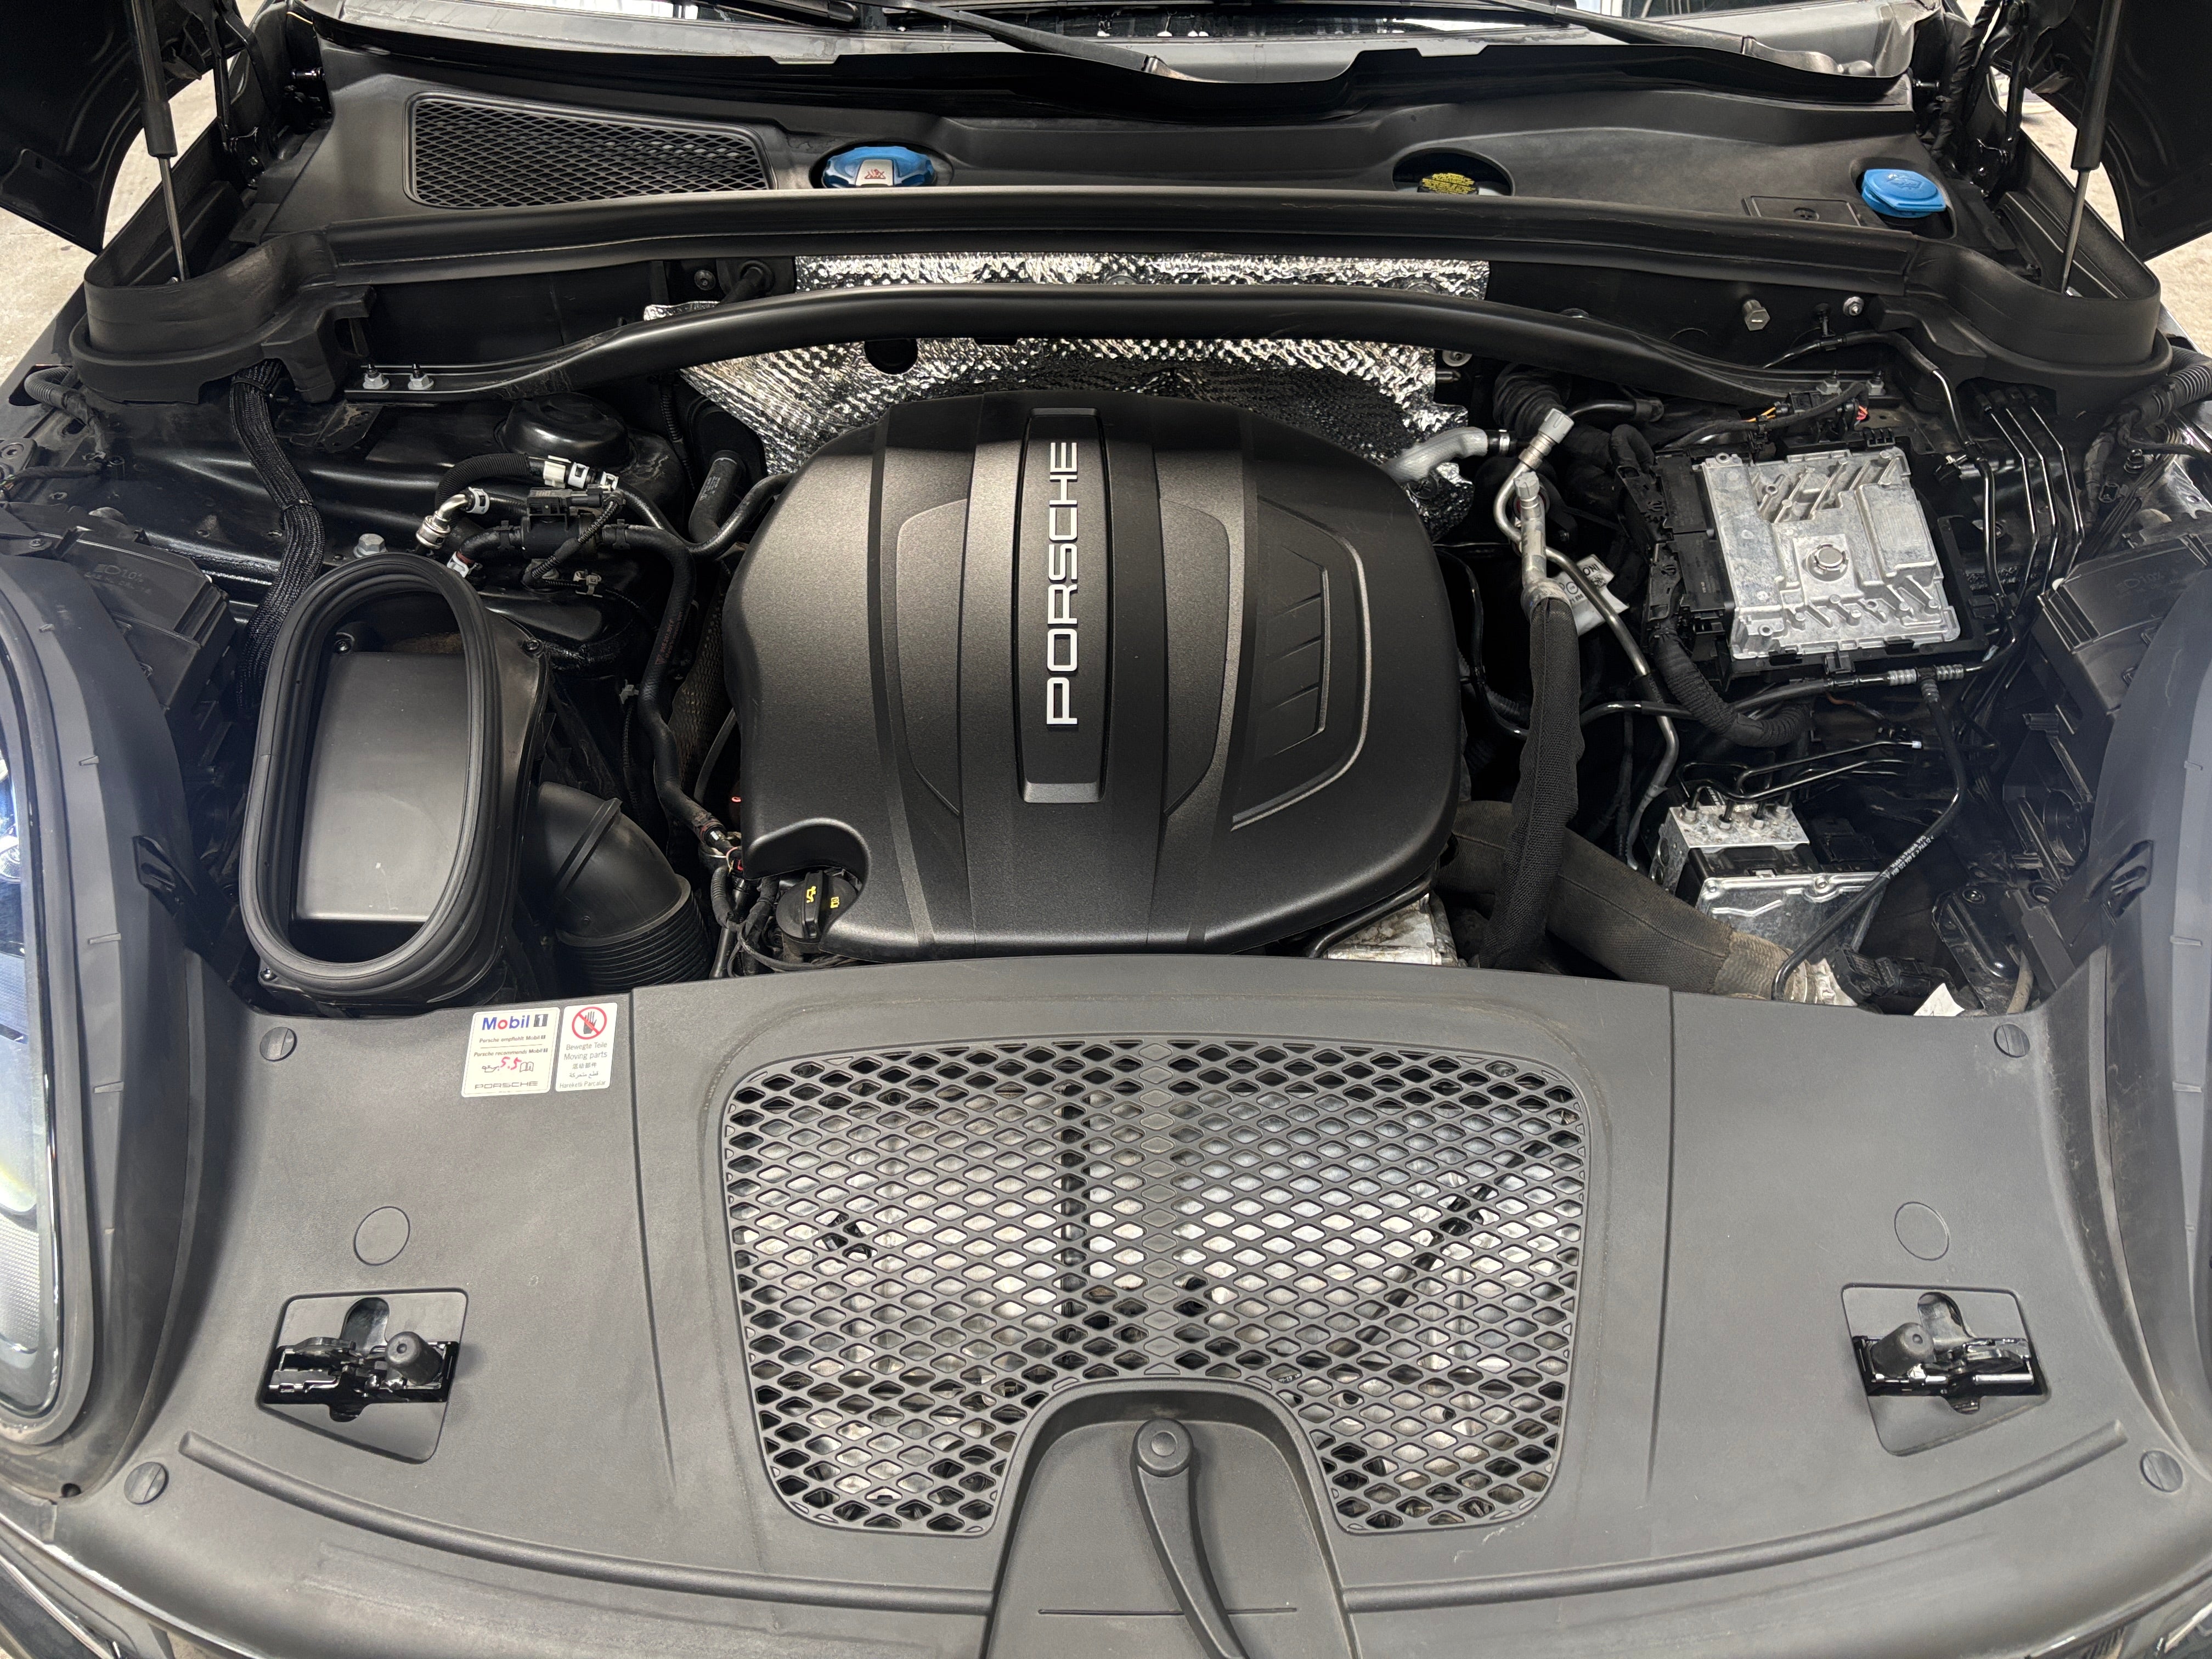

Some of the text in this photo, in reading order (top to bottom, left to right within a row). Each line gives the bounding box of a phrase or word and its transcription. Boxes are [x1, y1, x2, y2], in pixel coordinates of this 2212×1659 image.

[1583, 563, 1600, 576] ONI
[1047, 442, 1078, 725] PORSCHE
[482, 1015, 530, 1030] Mobil
[590, 1051, 607, 1059] parts
[500, 1056, 522, 1070] 5.5
